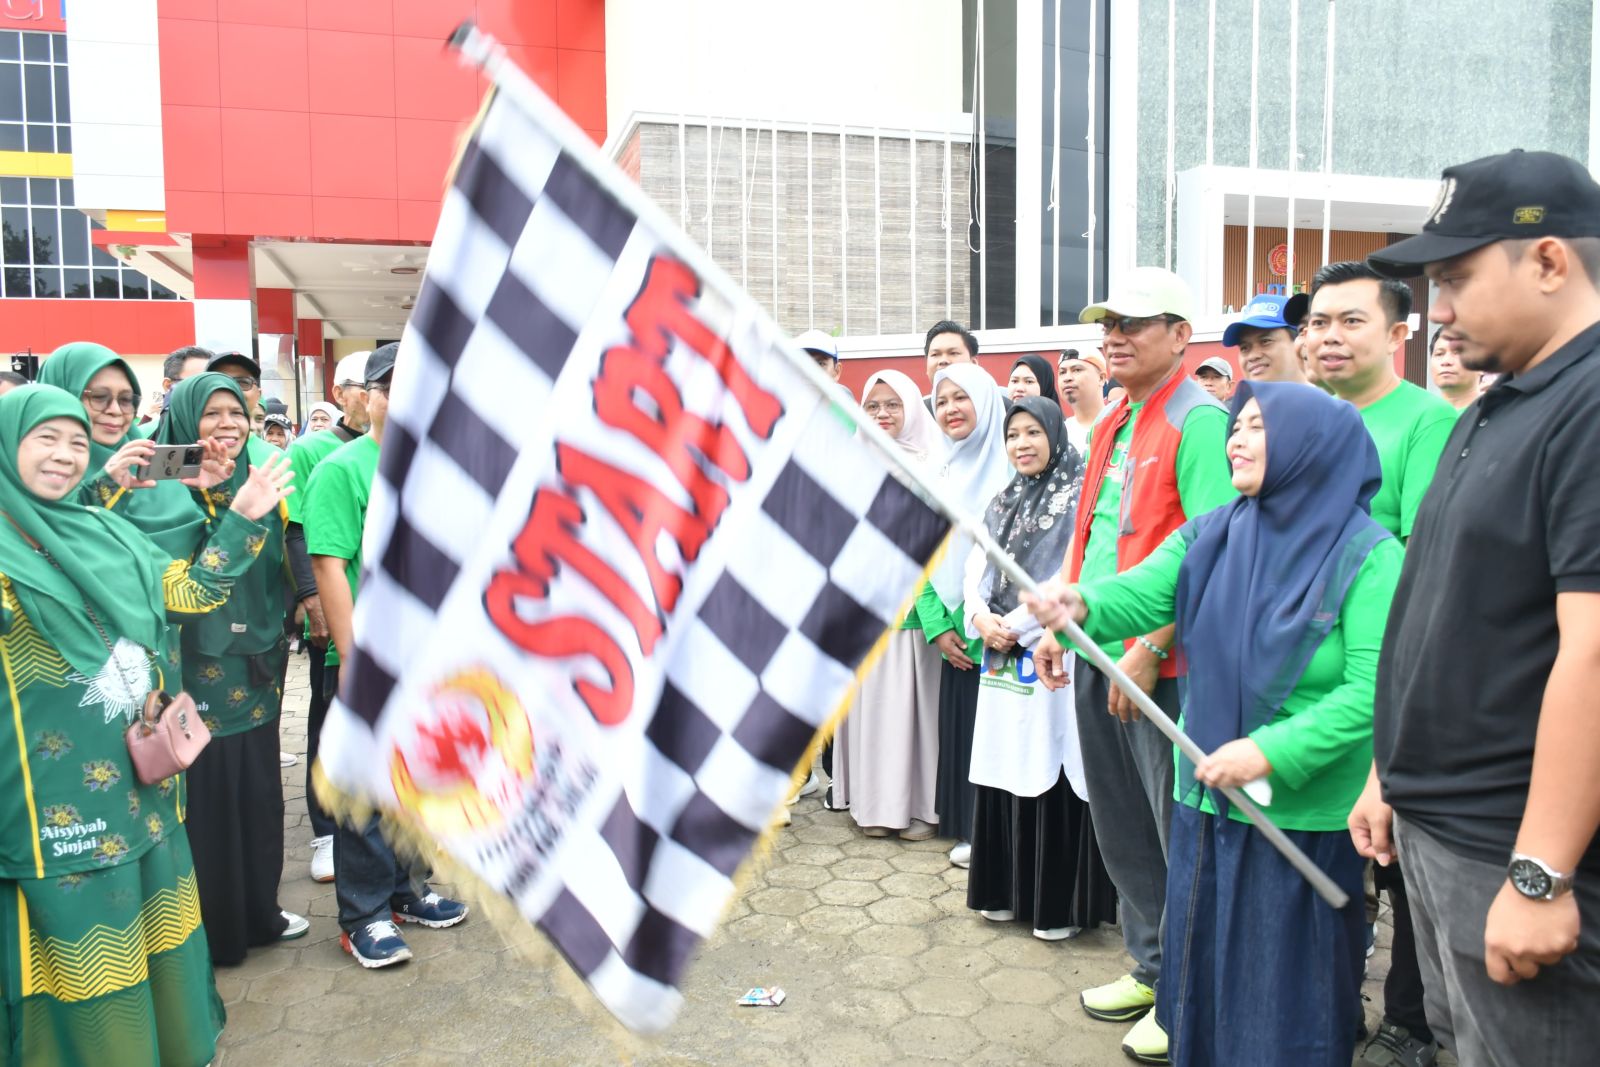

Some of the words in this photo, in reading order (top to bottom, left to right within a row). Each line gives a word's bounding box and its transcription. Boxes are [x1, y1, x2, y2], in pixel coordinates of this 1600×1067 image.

[482, 254, 785, 727] START
[40, 818, 107, 841] Aisyiyah
[53, 836, 97, 857] Sinjai
